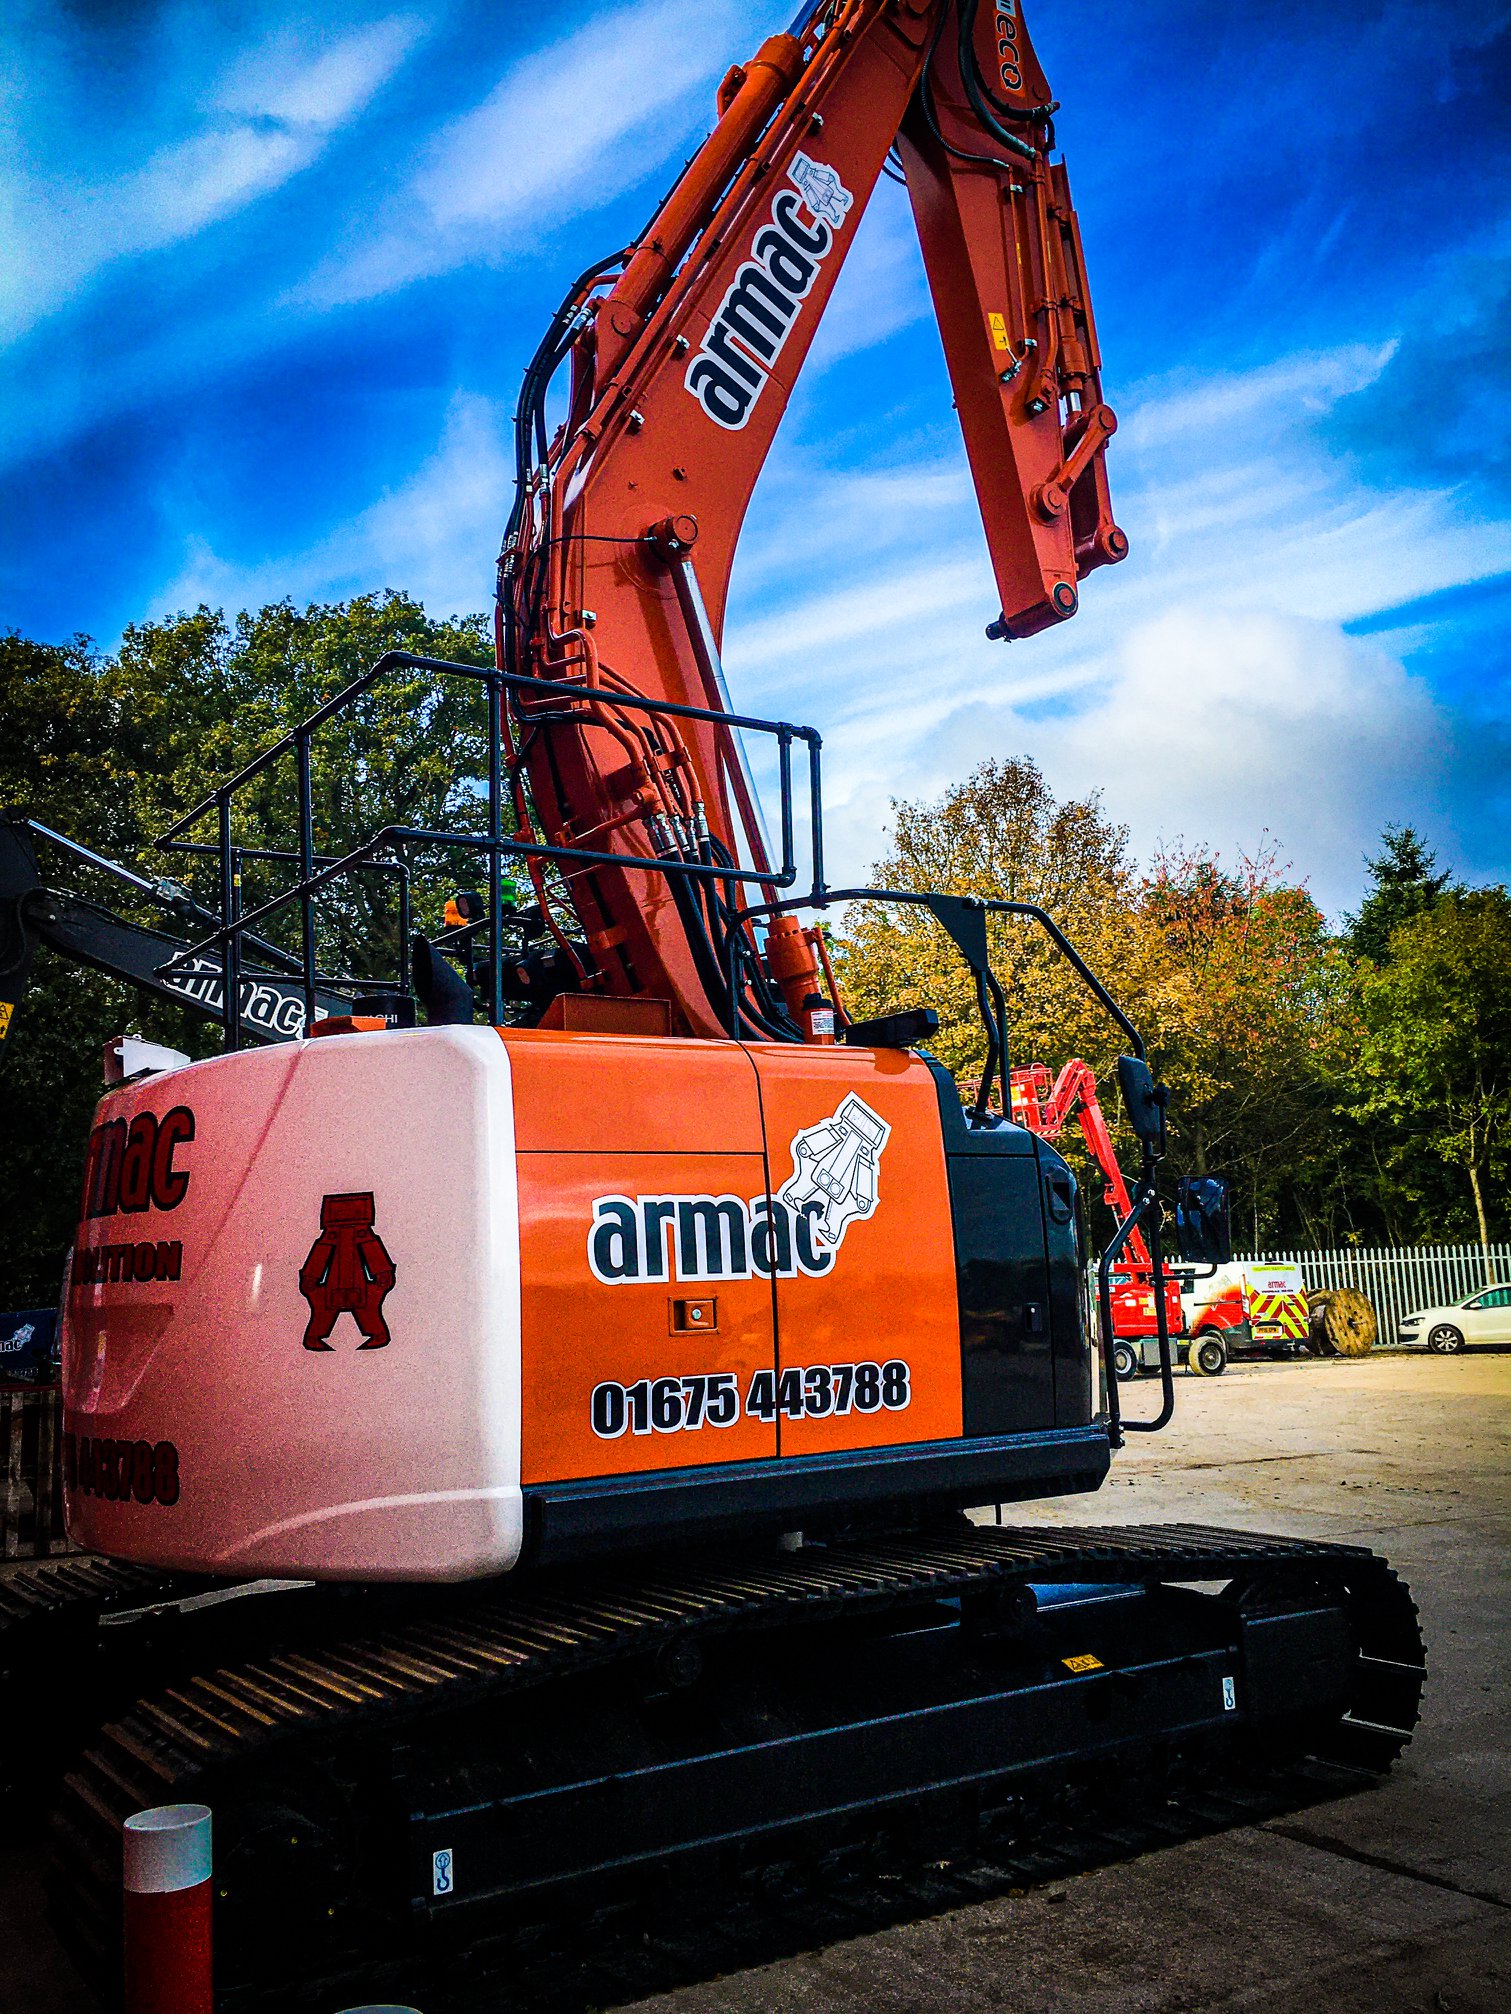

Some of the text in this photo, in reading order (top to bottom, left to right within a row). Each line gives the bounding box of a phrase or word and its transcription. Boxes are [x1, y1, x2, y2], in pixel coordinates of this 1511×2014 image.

[995, 13, 1022, 91] eco
[684, 189, 833, 430] armac
[587, 1193, 837, 1284] armac
[590, 1359, 910, 1439] 01675 443788
